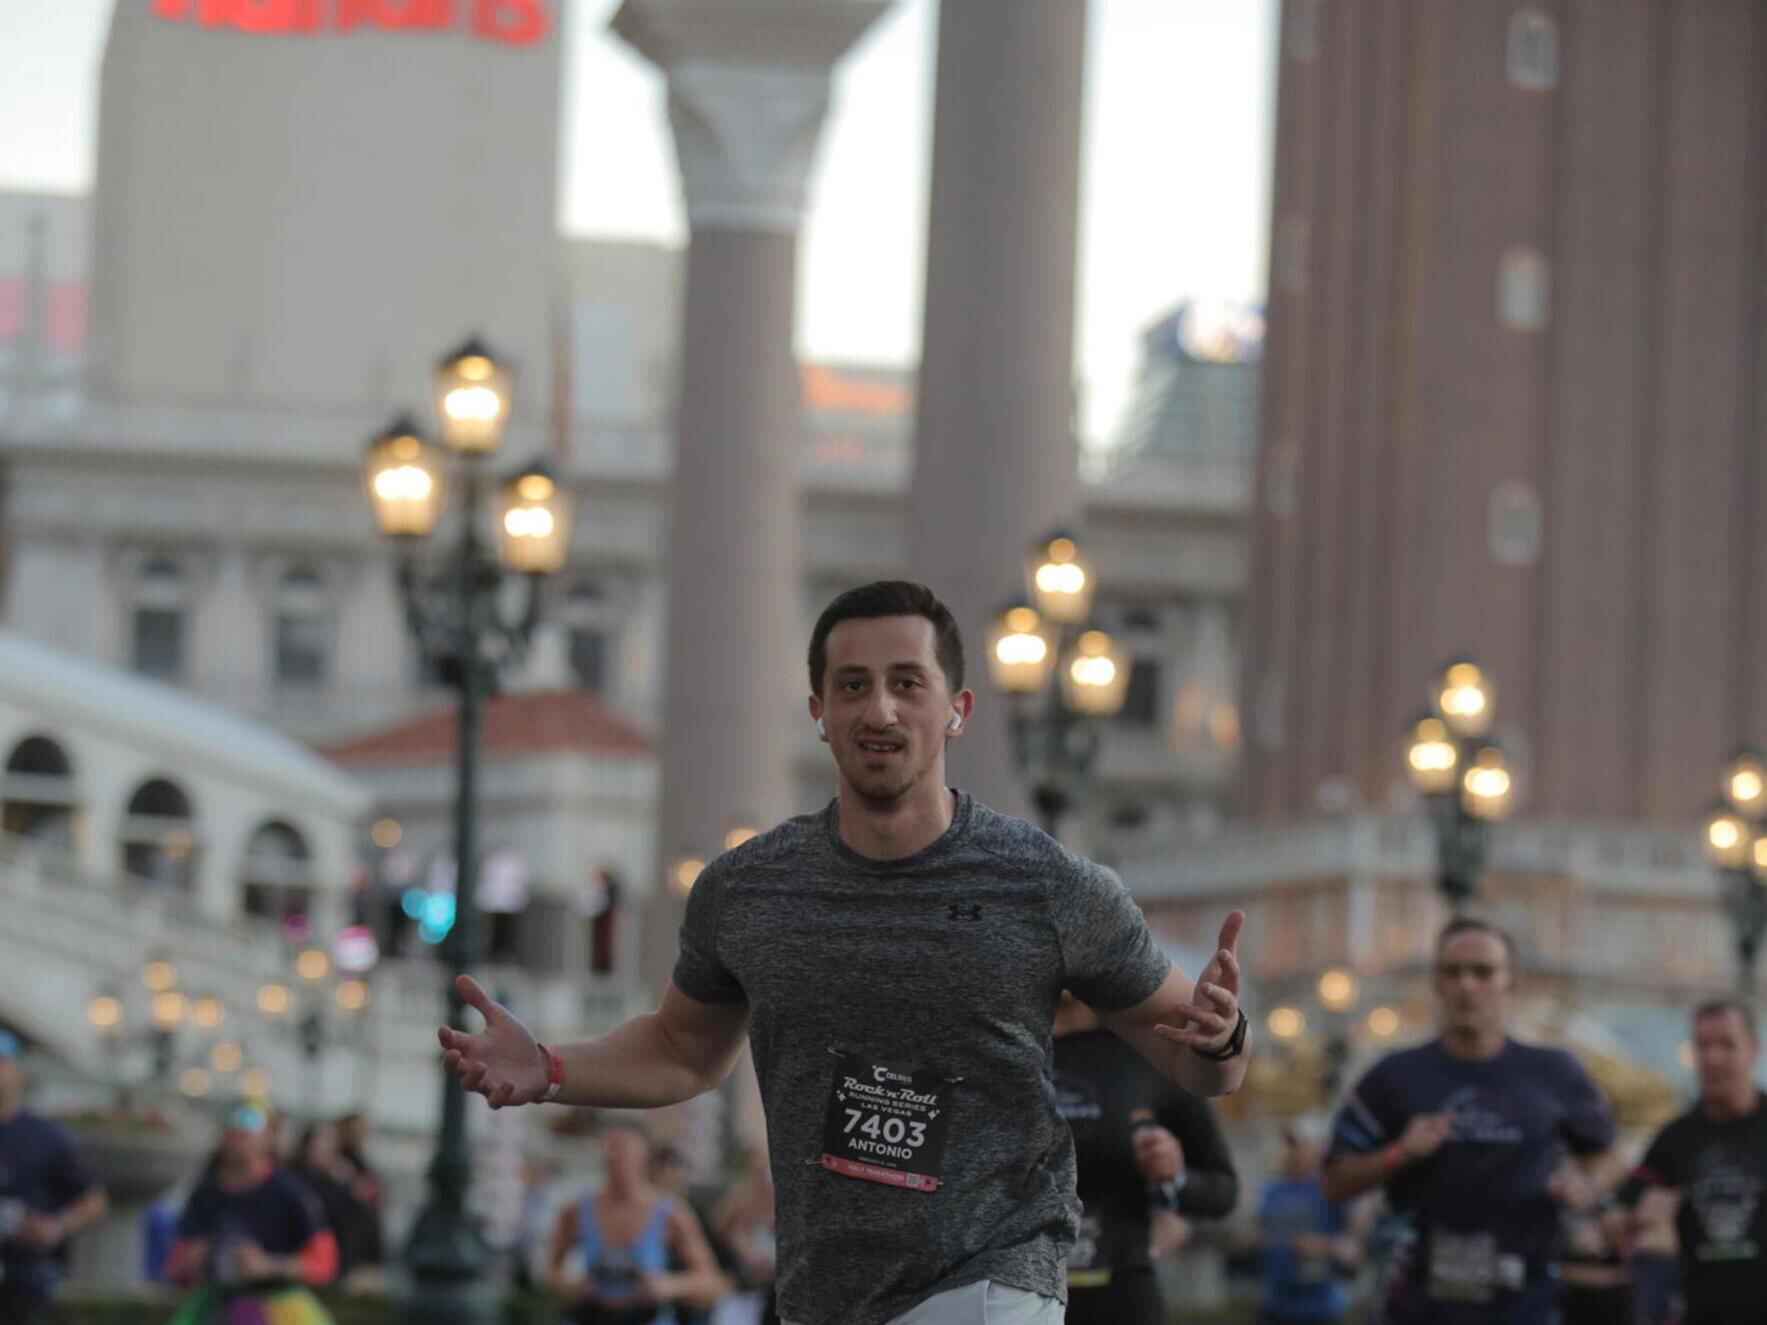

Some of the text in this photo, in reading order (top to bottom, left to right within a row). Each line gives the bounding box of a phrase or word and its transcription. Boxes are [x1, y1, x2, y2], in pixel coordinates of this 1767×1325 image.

[843, 1076, 886, 1096] Rock
[899, 1088, 937, 1105] Roll
[860, 1102, 913, 1117] LAS VEGAS
[891, 1100, 927, 1112] SERIES
[843, 1108, 927, 1147] 7403
[848, 1137, 913, 1160] ANTONIO
